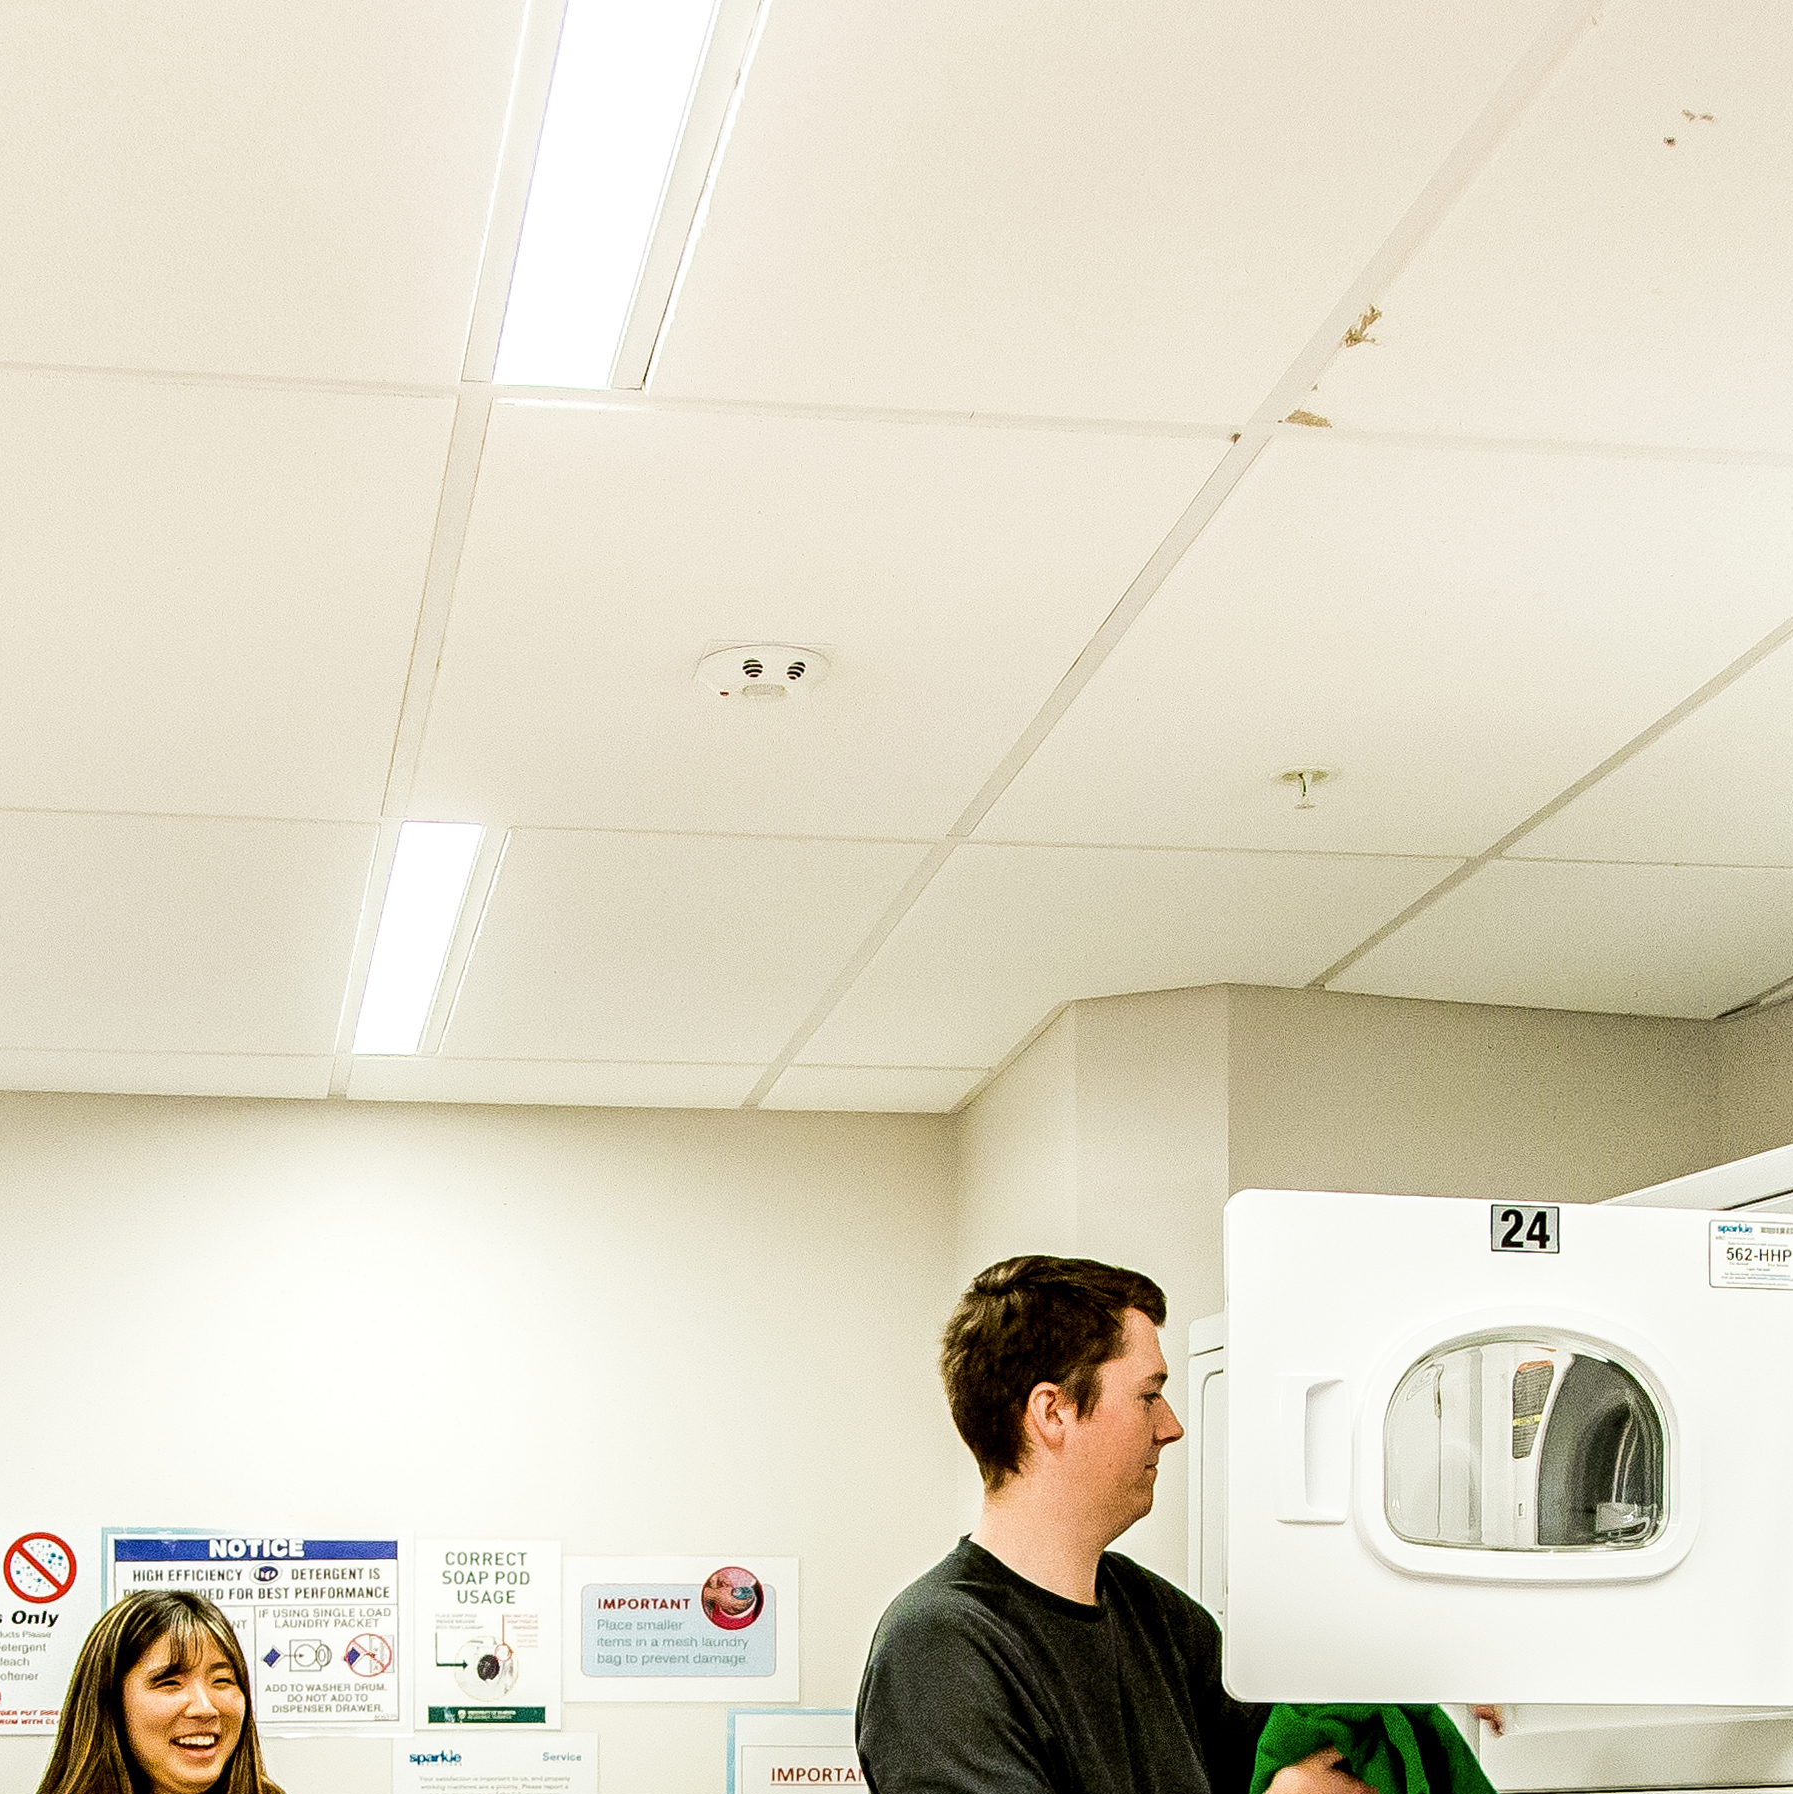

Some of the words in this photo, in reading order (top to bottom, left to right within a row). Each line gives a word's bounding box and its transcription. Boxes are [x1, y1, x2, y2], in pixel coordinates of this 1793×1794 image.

[1500, 1210, 1551, 1249] 24
[1726, 1247, 1792, 1262] 562-HHP
[209, 1538, 305, 1558] NOTICE
[445, 1551, 528, 1566] CORRECT
[133, 1569, 164, 1582] HIGH
[168, 1569, 243, 1582] EFFICIENCY
[291, 1568, 364, 1581] DETERGENT
[369, 1568, 381, 1580] IS
[442, 1570, 489, 1585] SOAP
[494, 1570, 531, 1585] POD
[228, 1588, 253, 1600] FOR
[258, 1588, 289, 1600] BEST
[294, 1586, 390, 1599] PERFORMANCE
[457, 1590, 516, 1604] USAGE
[597, 1598, 691, 1610] IMPORTANT
[11, 1609, 60, 1627] Only
[258, 1609, 269, 1618] IF
[273, 1608, 309, 1618] USING
[312, 1608, 355, 1618] SINGLE
[359, 1608, 392, 1618] LOAD
[274, 1618, 331, 1628] LAUNDRY
[334, 1618, 379, 1628] PACKET
[596, 1619, 633, 1631] Place
[636, 1619, 684, 1631] smaller
[597, 1636, 632, 1647] items
[635, 1636, 647, 1647] in
[651, 1639, 658, 1647] a
[662, 1636, 698, 1647] mesh
[702, 1636, 749, 1650] laundry
[597, 1653, 622, 1667] bag
[626, 1654, 637, 1664] to
[641, 1654, 689, 1667] prevent
[265, 1683, 288, 1692] ADD
[290, 1683, 304, 1692] TO
[306, 1683, 351, 1692] WASHER
[354, 1683, 388, 1692] DRUM.
[287, 1693, 302, 1702] DO
[305, 1693, 327, 1702] NOT
[331, 1693, 353, 1702] ADD
[354, 1693, 368, 1702] TO
[272, 1704, 334, 1713] DISPENSER
[336, 1704, 384, 1713] DRAWER.
[409, 1750, 462, 1765] sparkle
[542, 1752, 582, 1762] Service
